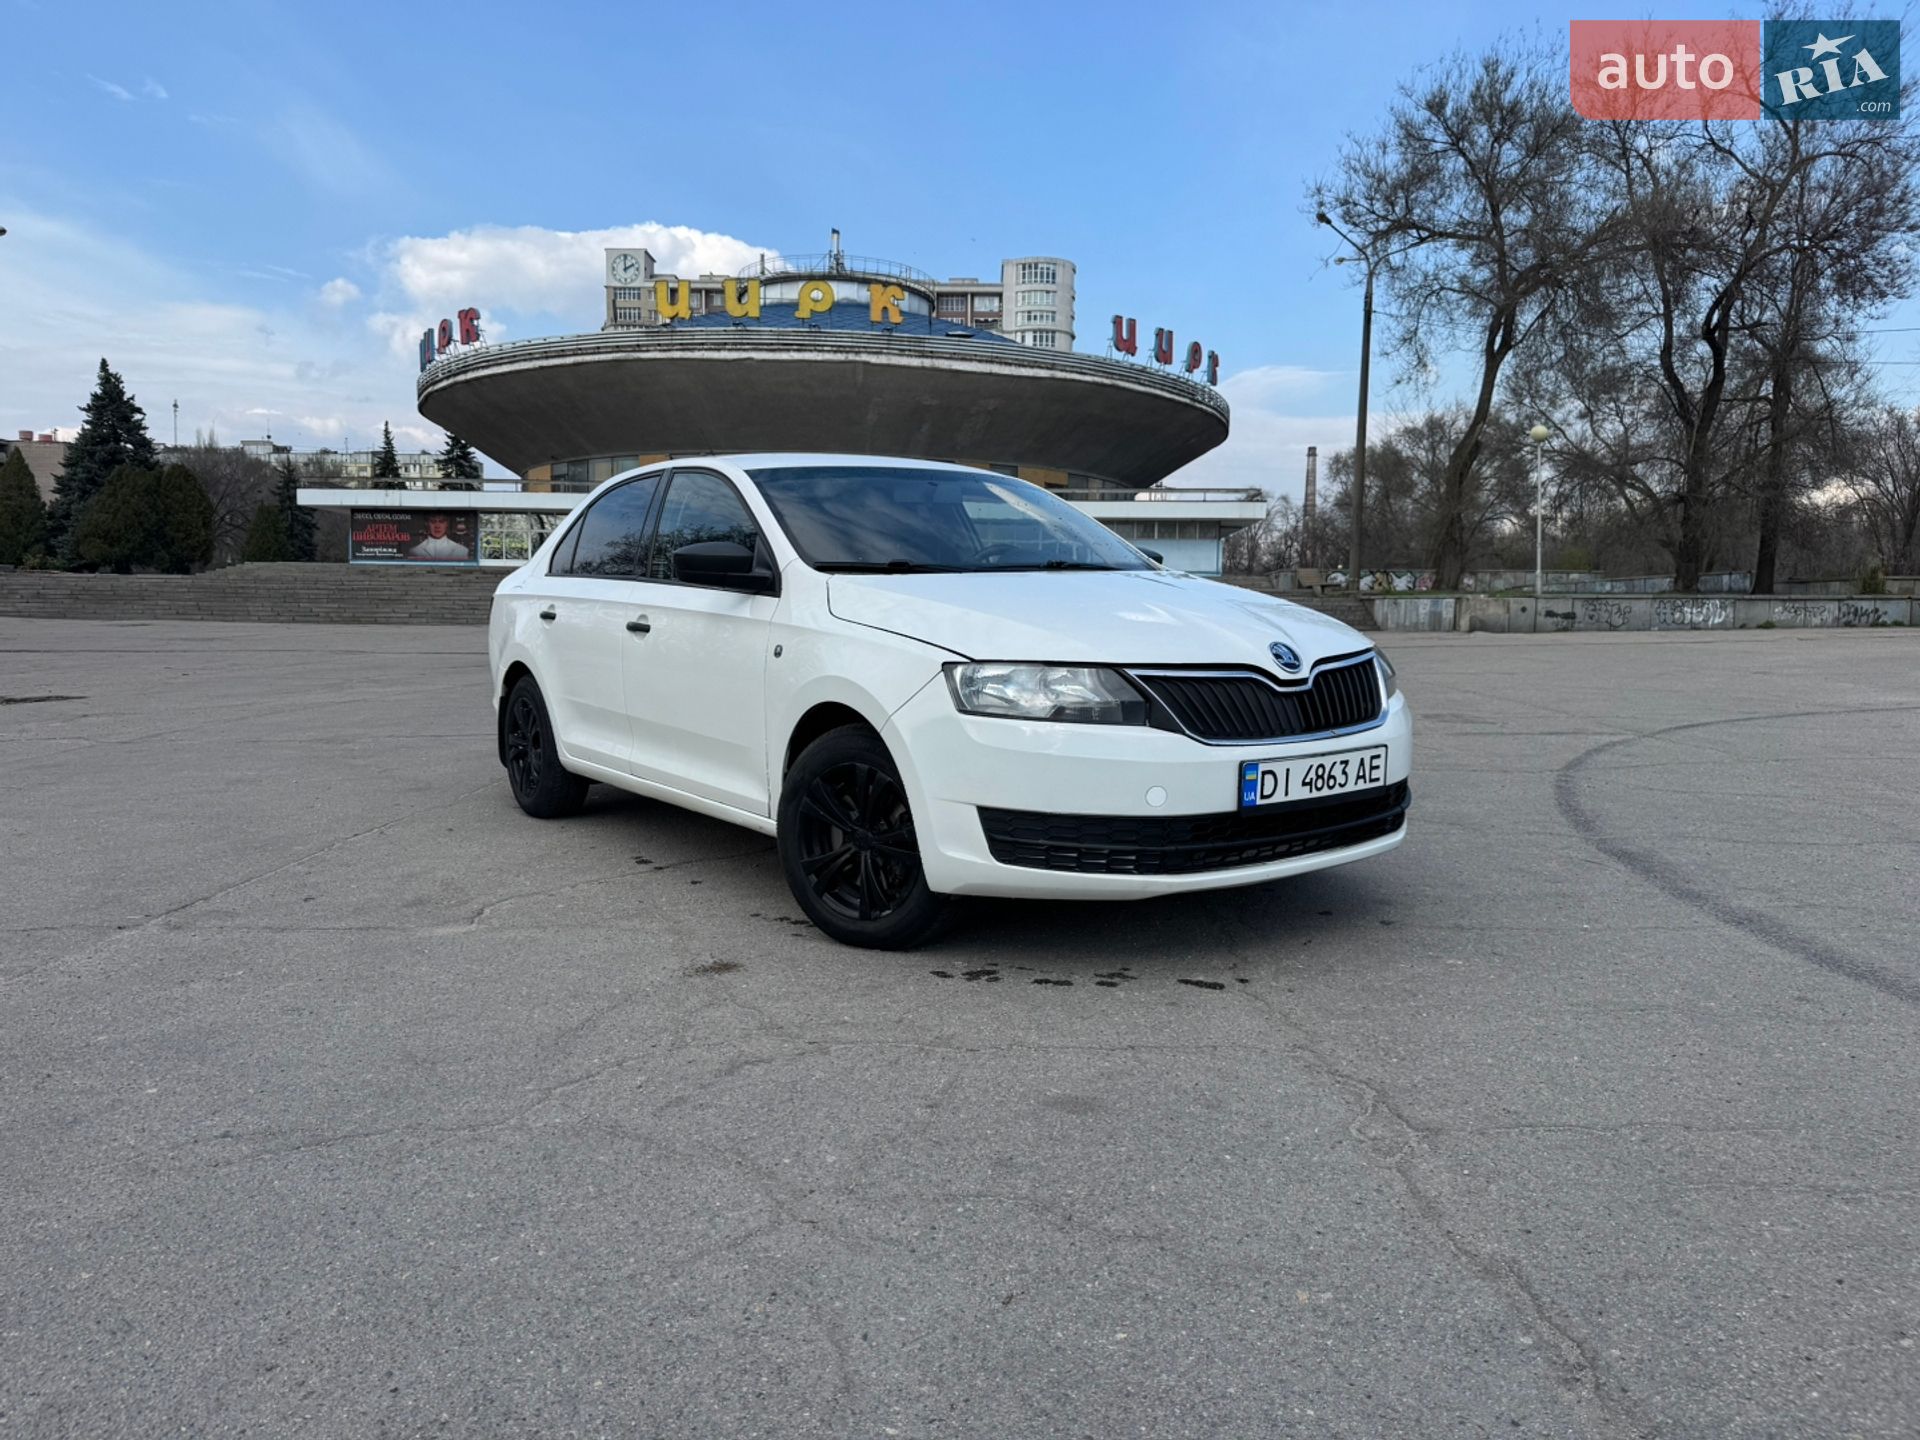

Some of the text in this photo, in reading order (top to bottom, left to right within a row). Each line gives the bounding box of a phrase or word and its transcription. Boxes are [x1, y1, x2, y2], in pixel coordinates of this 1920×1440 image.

[1259, 753, 1382, 800] DI 4863 AE
[1243, 792, 1256, 802] UA
